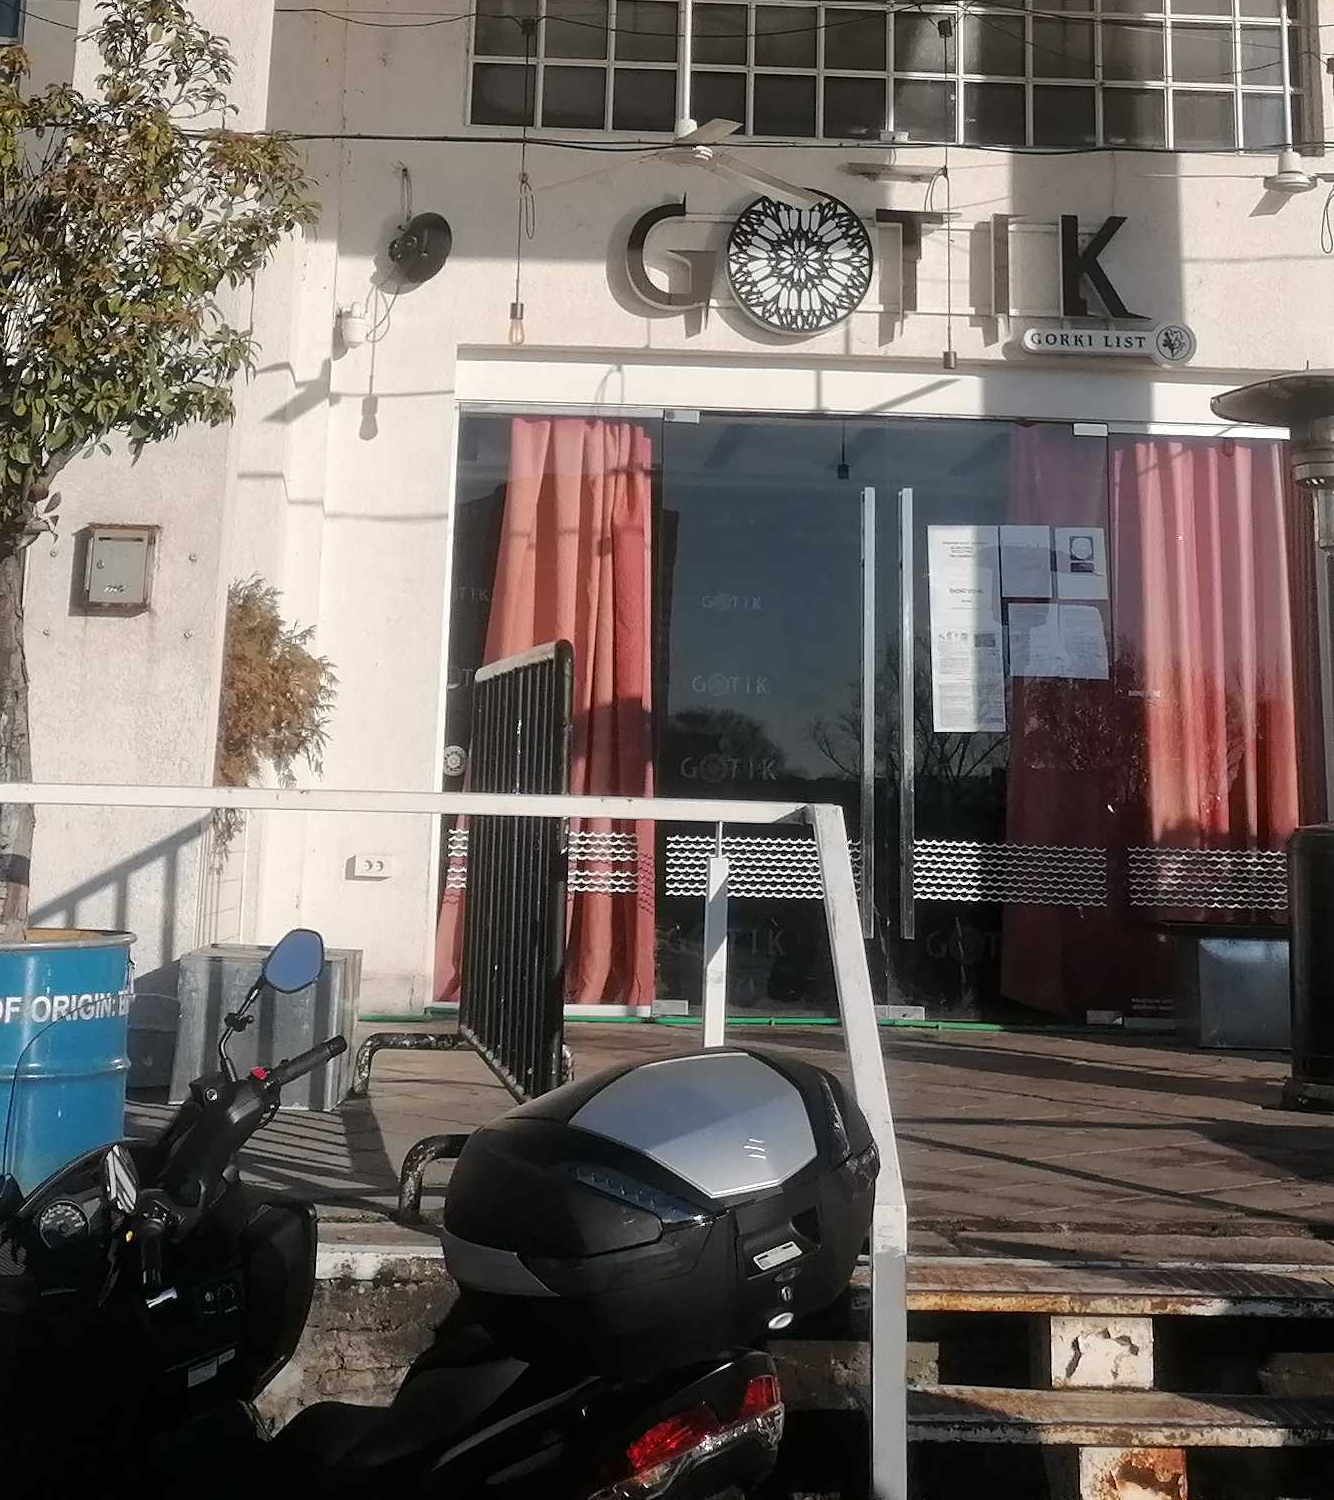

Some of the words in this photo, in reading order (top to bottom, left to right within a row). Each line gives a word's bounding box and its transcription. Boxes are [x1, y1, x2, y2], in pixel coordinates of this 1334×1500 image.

[1031, 332, 1093, 347] GORKI
[1104, 335, 1147, 349] LIST
[31, 991, 116, 1023] ORIGIN:
